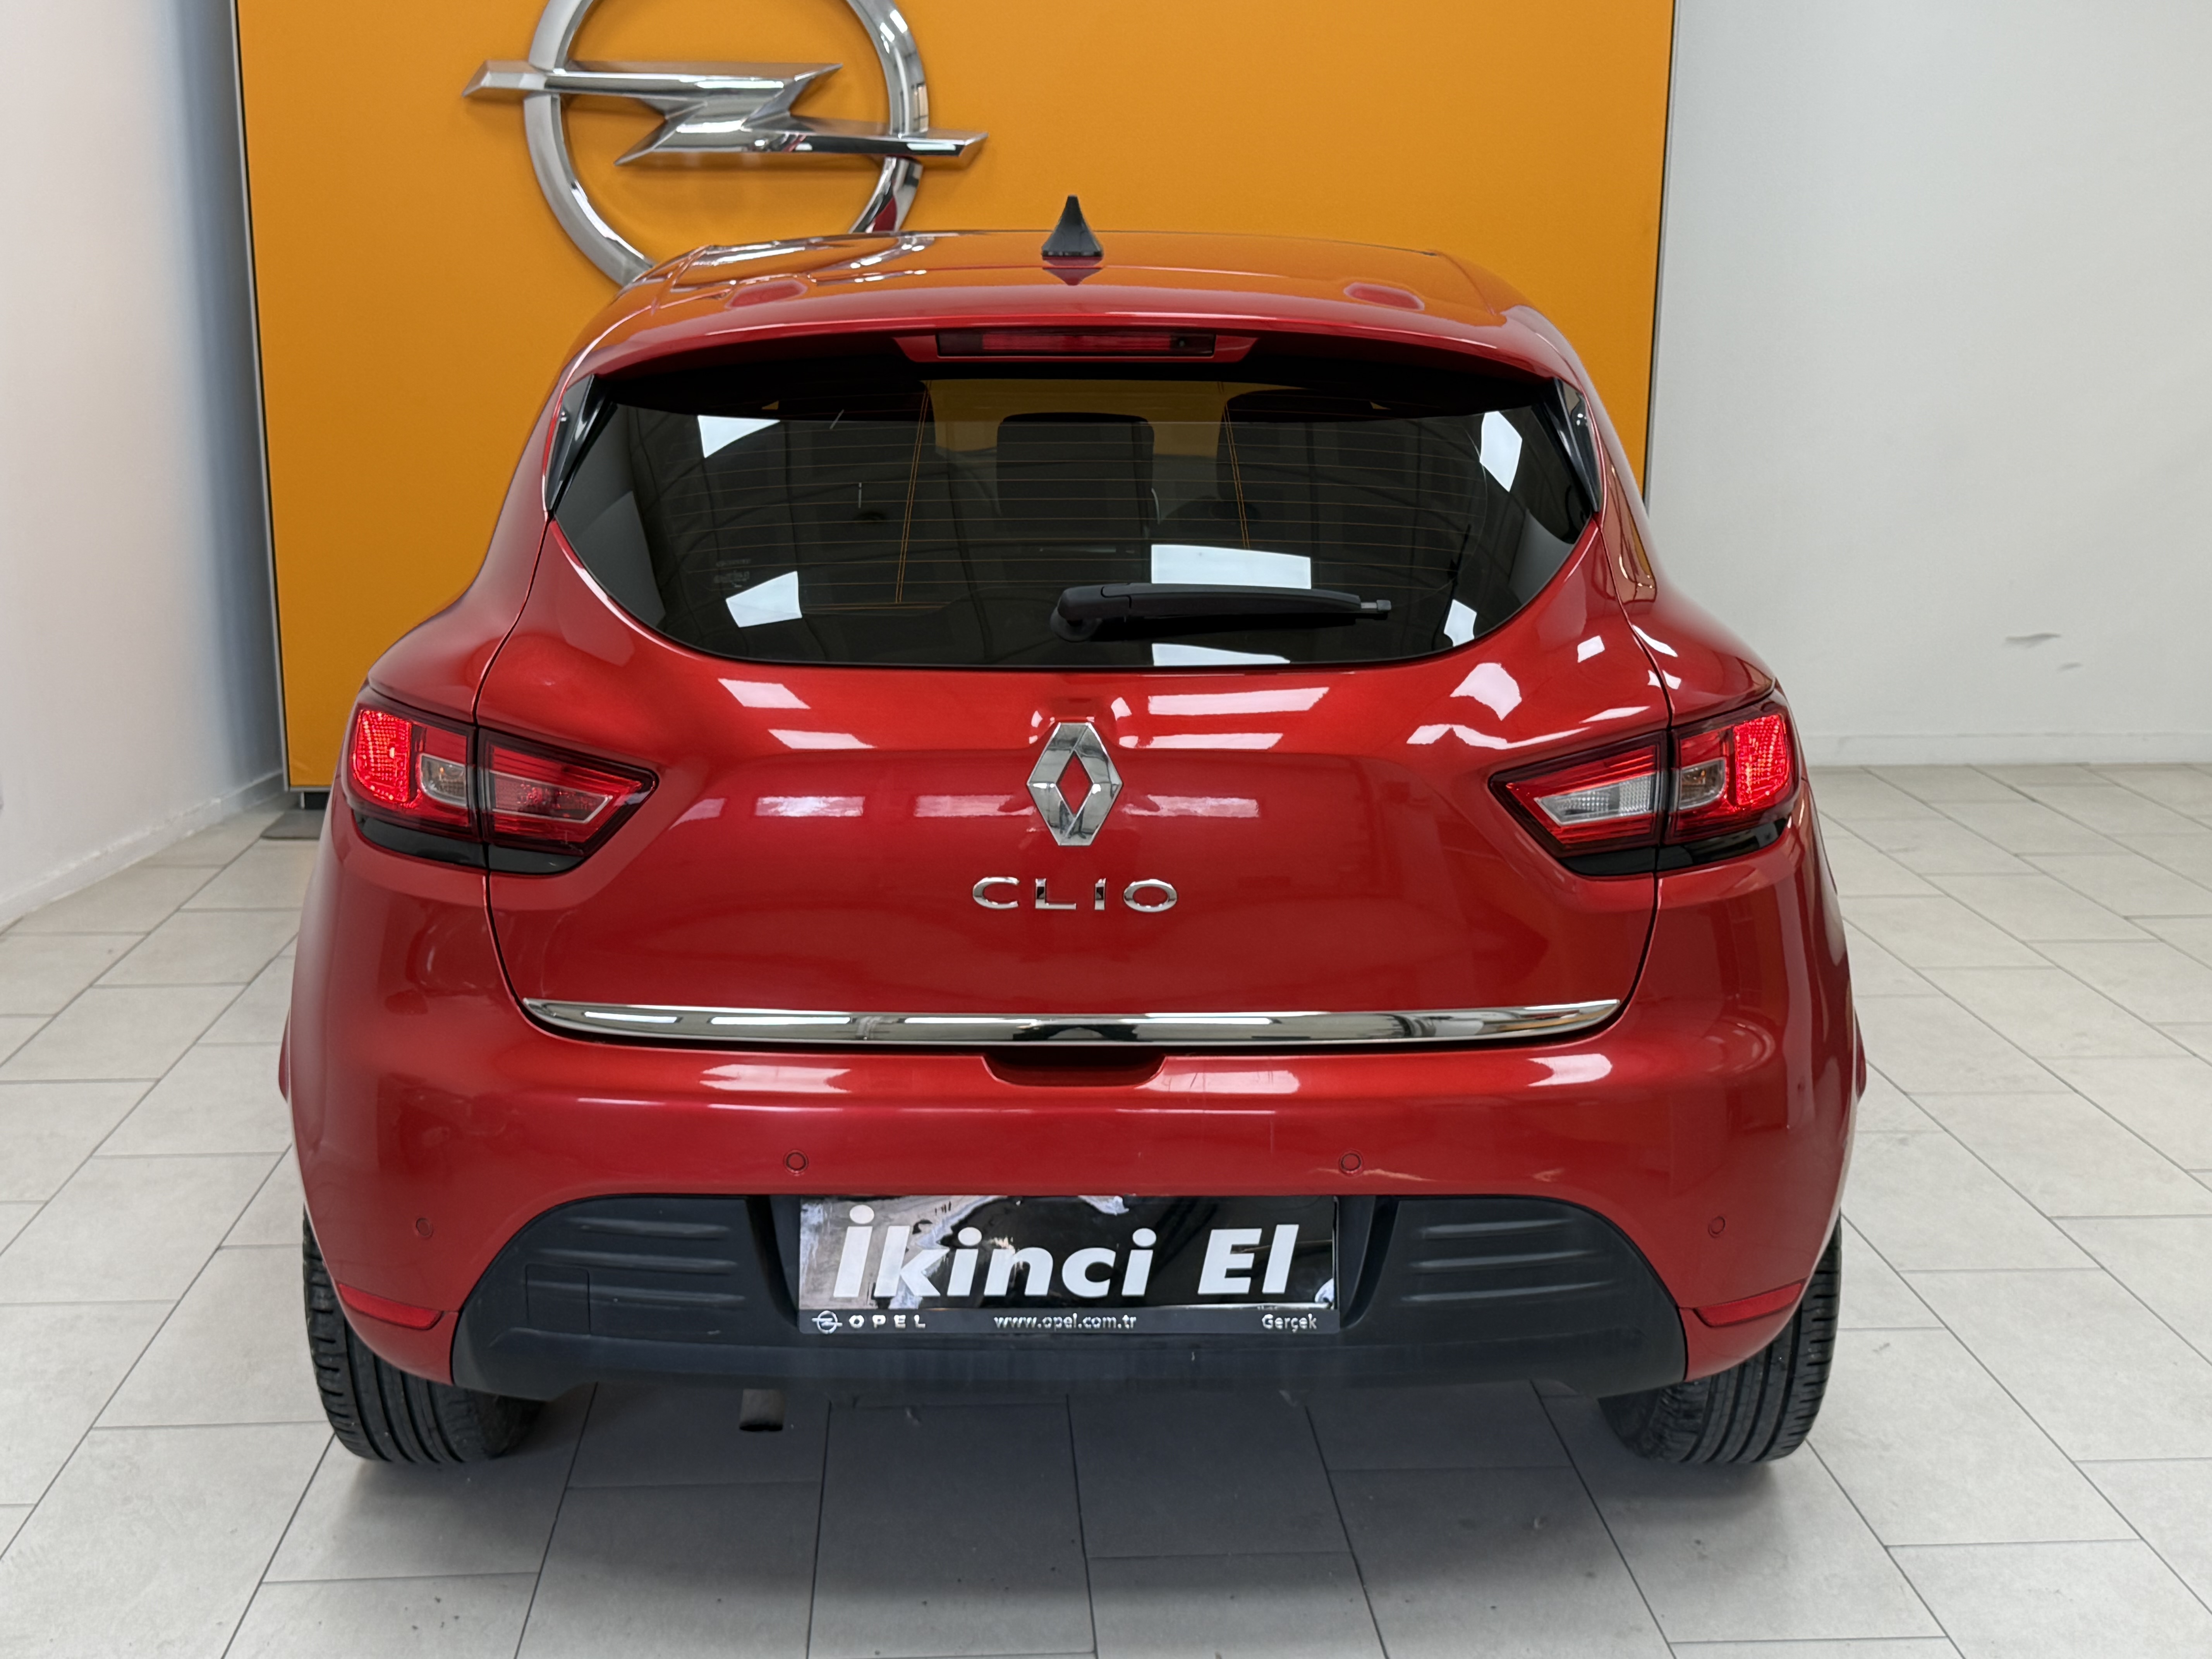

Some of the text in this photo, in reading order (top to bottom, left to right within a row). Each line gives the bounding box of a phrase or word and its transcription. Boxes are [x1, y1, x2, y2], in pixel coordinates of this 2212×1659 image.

[972, 876, 1178, 913] CLIO
[1197, 1224, 1299, 1295] El
[848, 1314, 926, 1329] OPEL
[994, 1313, 1137, 1332] www.opel.com.tr
[1262, 1313, 1317, 1333] Gerçek
